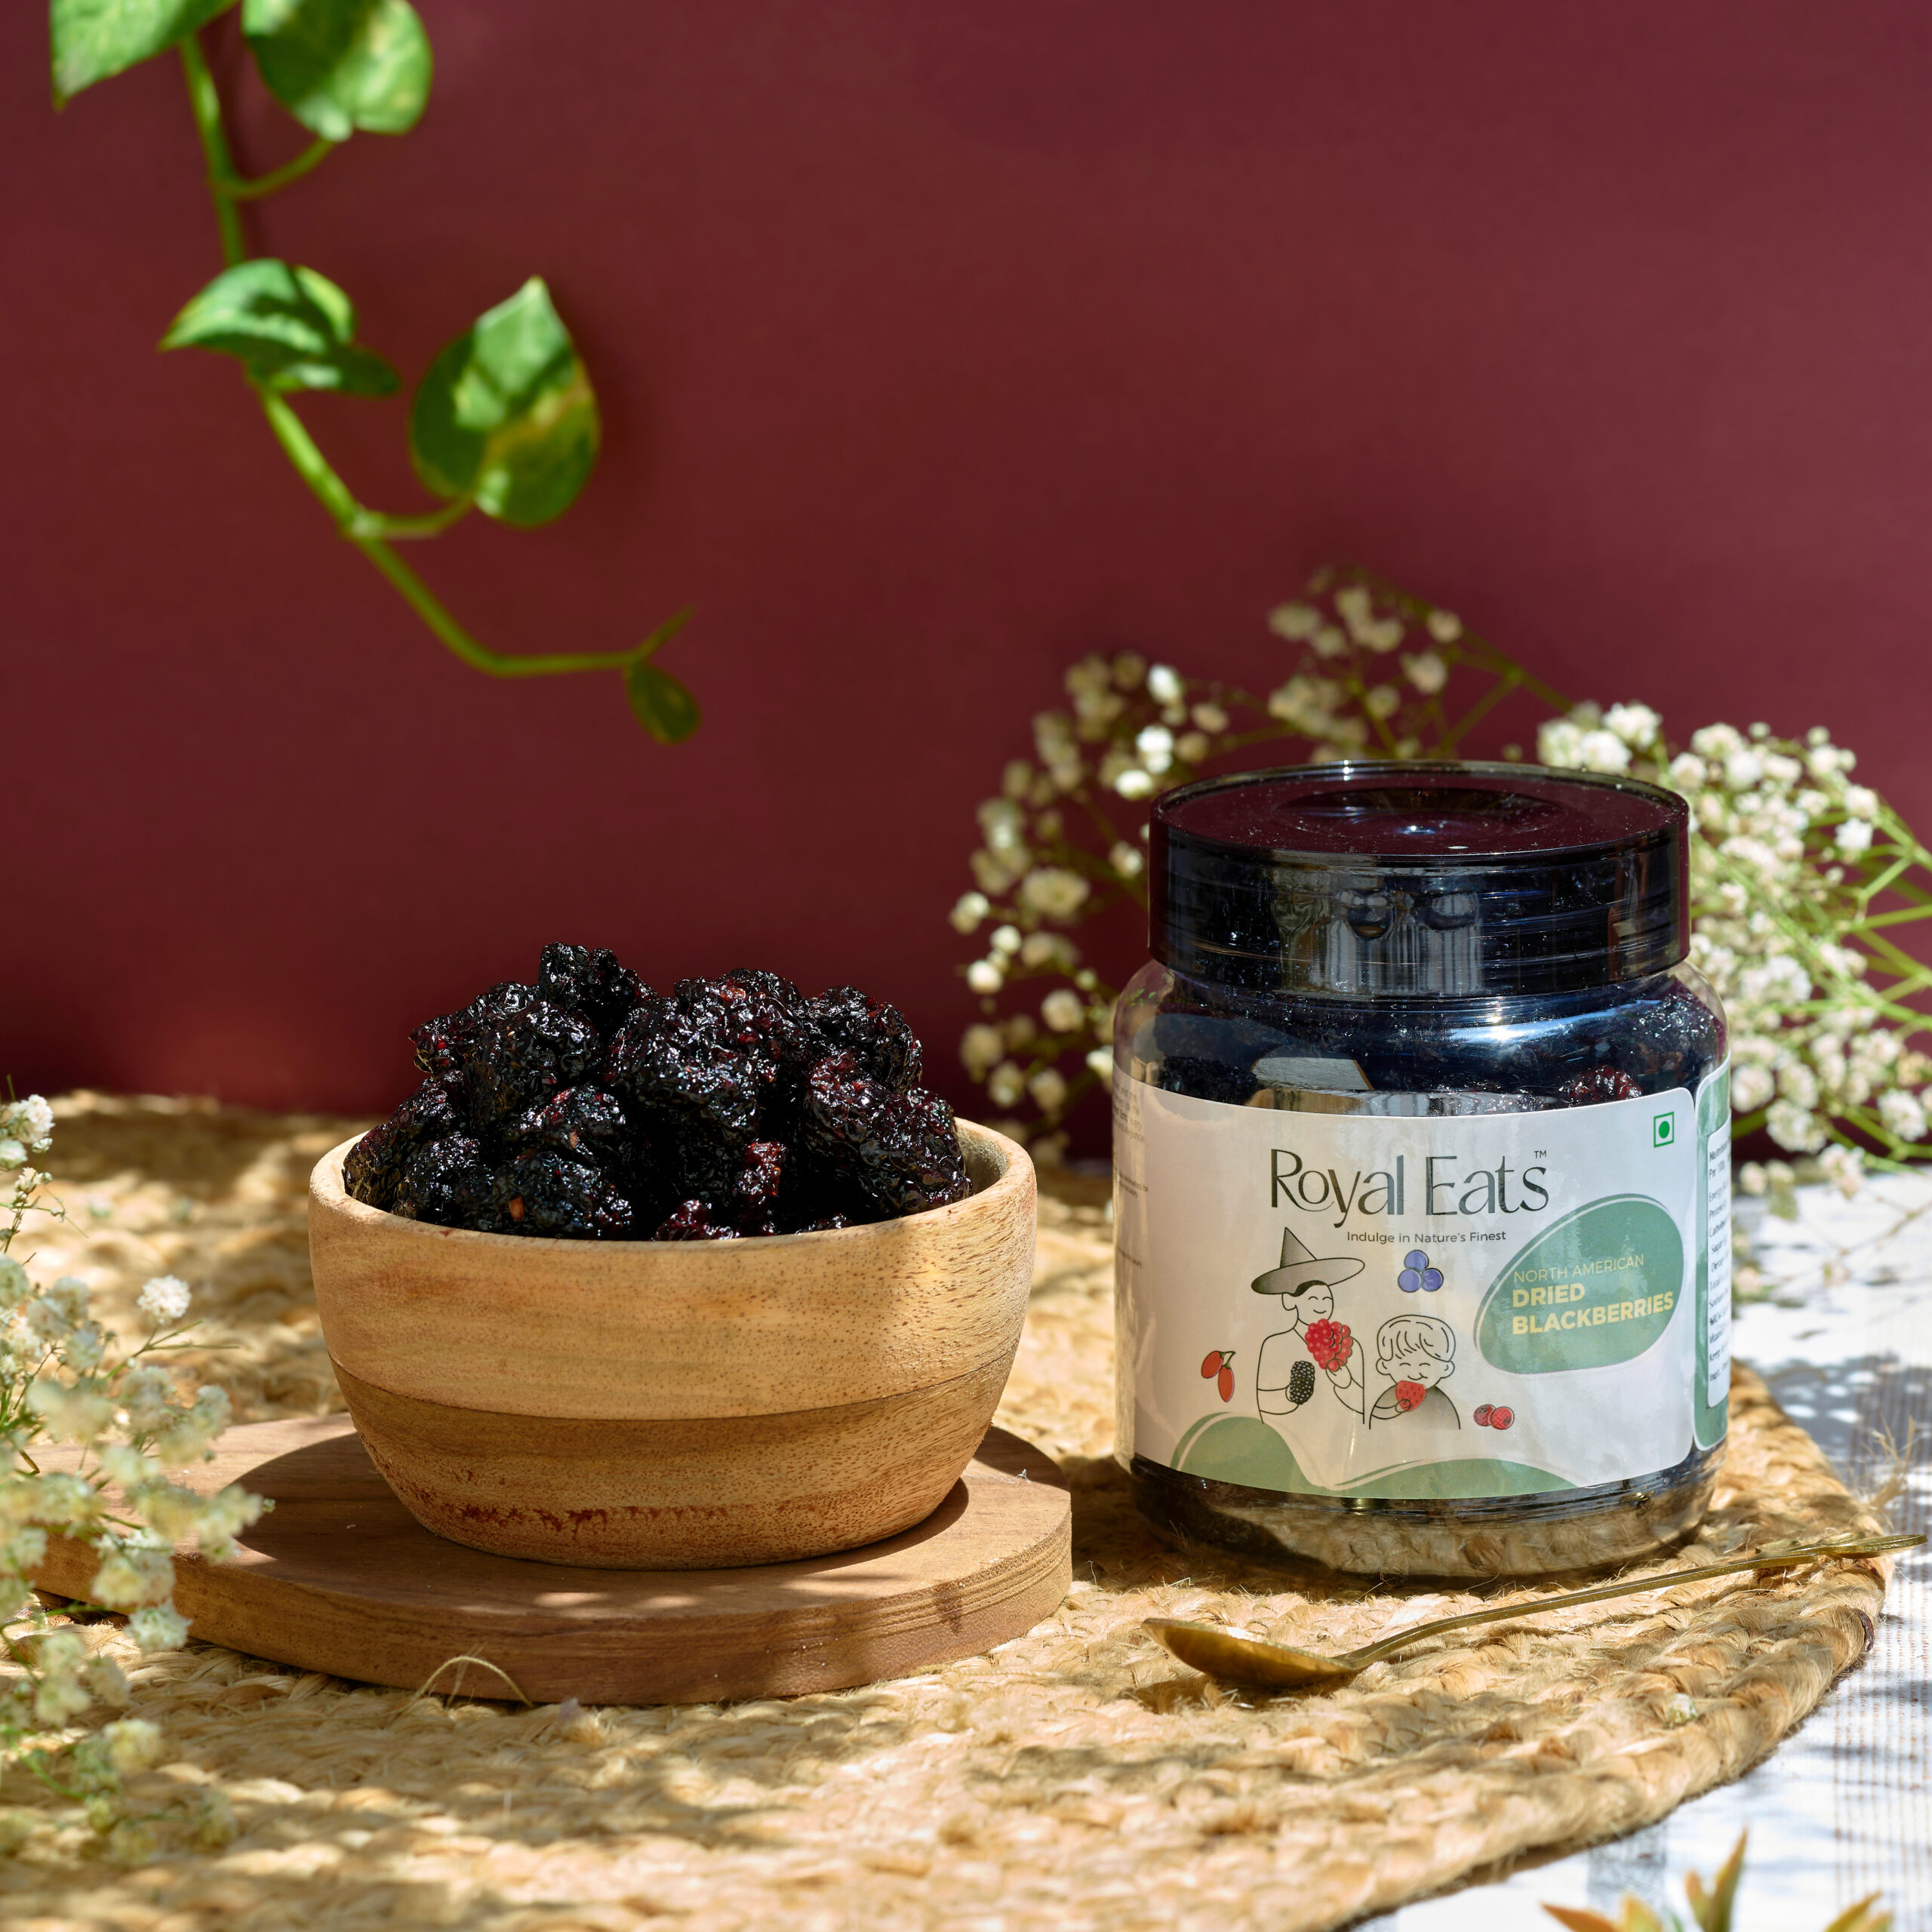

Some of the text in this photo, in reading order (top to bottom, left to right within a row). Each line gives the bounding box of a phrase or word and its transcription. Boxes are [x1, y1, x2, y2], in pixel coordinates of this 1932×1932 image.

[1271, 1149, 1549, 1228] Royal Eats TM
[1346, 1231, 1506, 1244] Indulge in Nature's Finest
[1513, 1254, 1644, 1284] NORTH AMERICAN
[1512, 1283, 1586, 1308] DRIED
[1512, 1291, 1674, 1335] BLACKBERRIES
